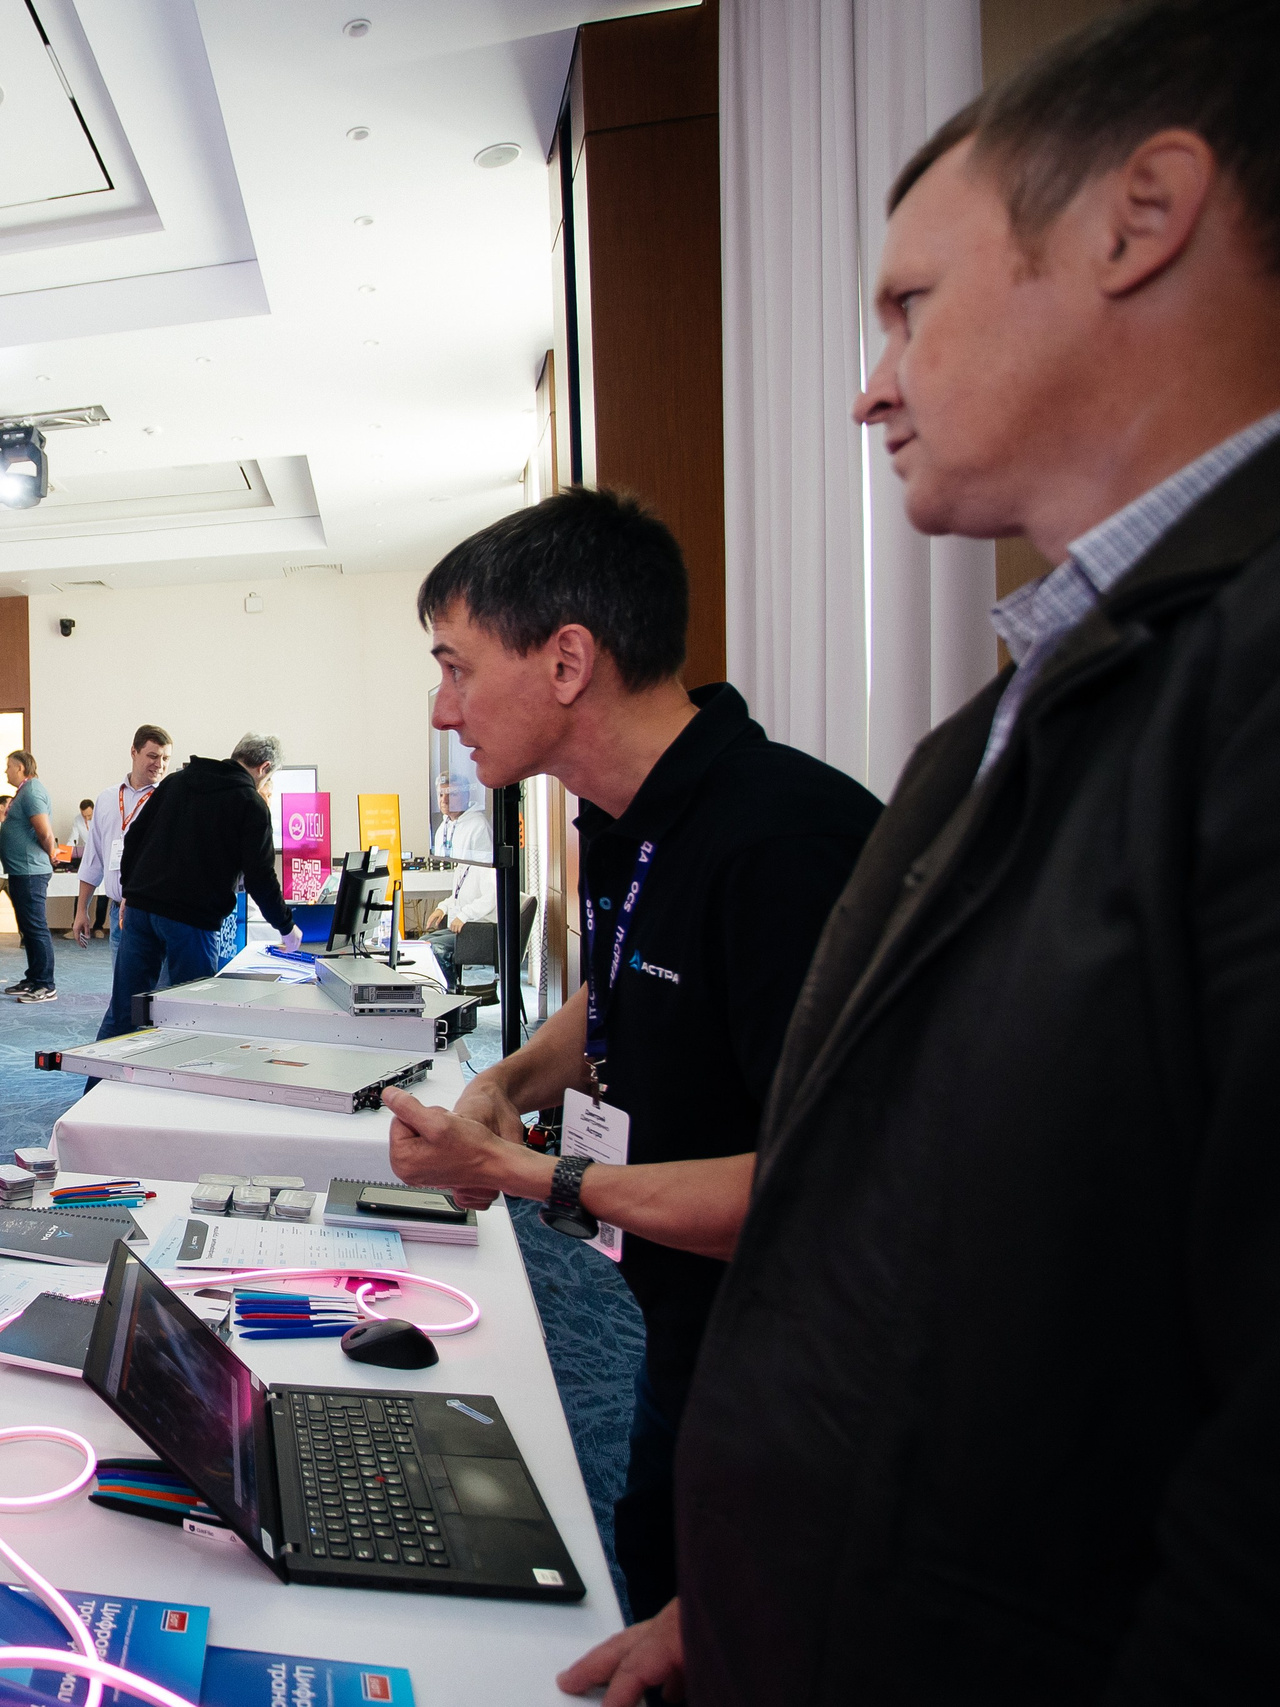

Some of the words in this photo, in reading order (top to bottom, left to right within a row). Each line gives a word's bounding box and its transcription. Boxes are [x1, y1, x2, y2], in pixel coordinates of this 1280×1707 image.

[305, 812, 324, 838] TEGU
[623, 881, 640, 913] OCS
[641, 961, 680, 985] АСТРА
[40, 1223, 60, 1242] АСТРА
[95, 1602, 123, 1663] Цифров
